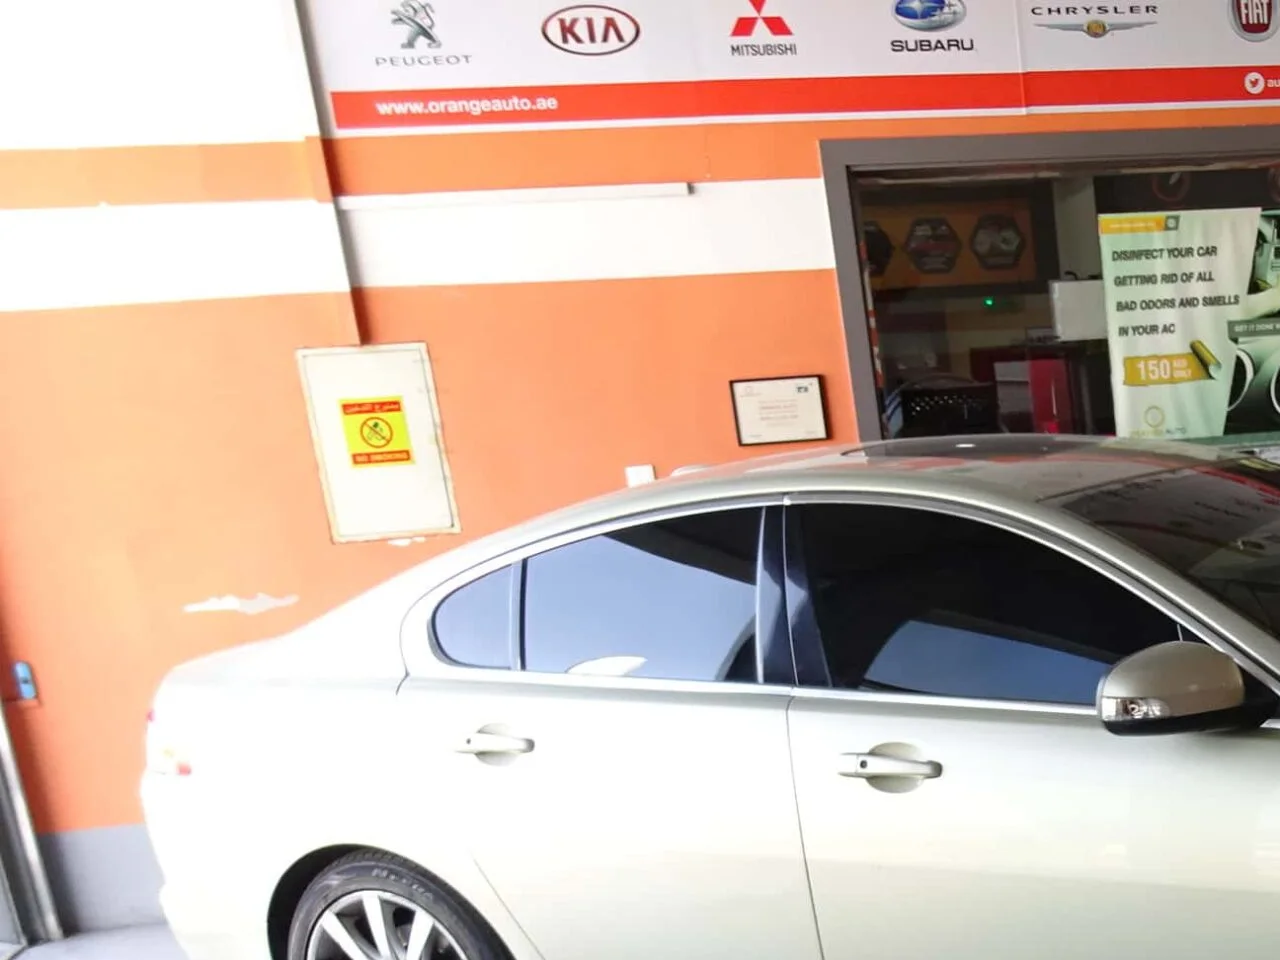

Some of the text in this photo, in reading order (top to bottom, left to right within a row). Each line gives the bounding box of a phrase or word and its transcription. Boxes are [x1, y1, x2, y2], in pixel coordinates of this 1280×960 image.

[1030, 5, 1159, 16] CHRYSLER
[558, 17, 626, 45] KIA
[730, 43, 798, 57] MITSUBISHI
[890, 38, 975, 53] SUBARU
[375, 54, 473, 67] PEUGEOT
[375, 95, 559, 117] www.orangeauto.ae
[1111, 245, 1218, 262] DISINFECT YOUR CAR
[1114, 271, 1215, 287] GETTING RID OF ALL
[1116, 294, 1240, 312] BAD ODORS AND SMELLS
[1118, 323, 1176, 337] IN YOUR AC
[1137, 358, 1171, 380] 150
